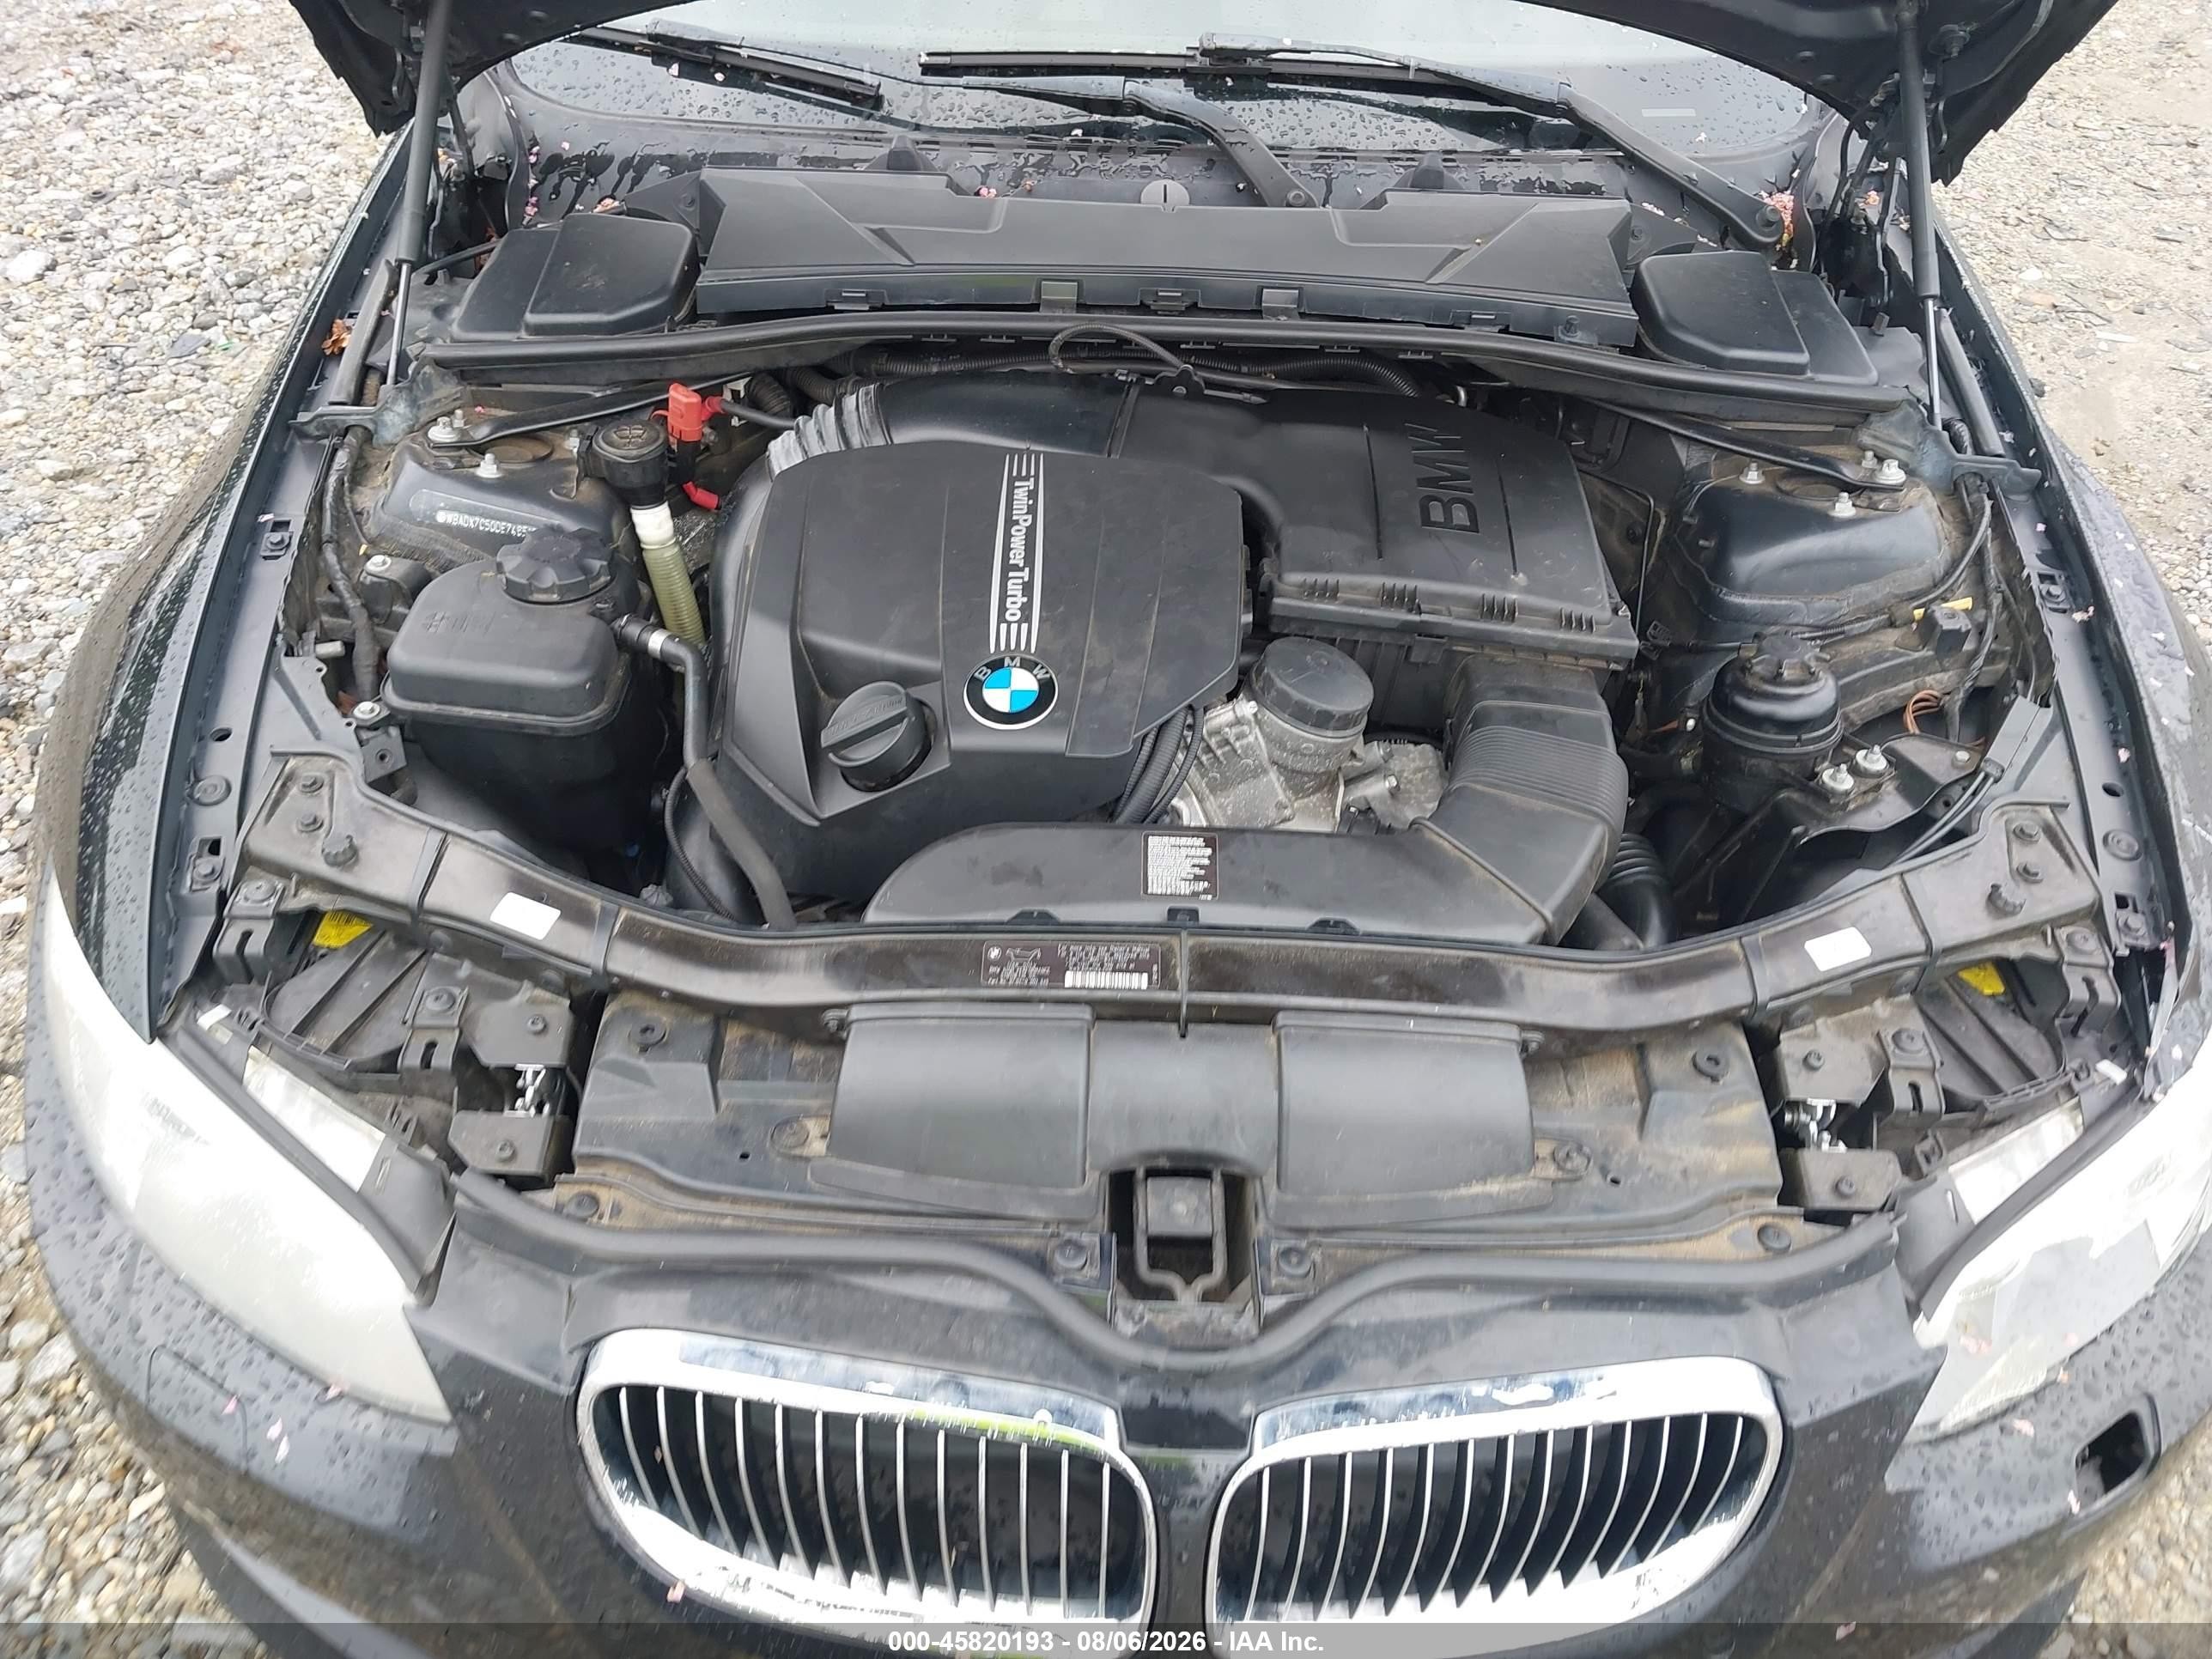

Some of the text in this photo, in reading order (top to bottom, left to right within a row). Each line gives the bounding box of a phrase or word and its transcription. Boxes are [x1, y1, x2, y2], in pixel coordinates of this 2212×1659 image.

[1402, 419, 1480, 535] BMW
[1005, 477, 1035, 622] TwinPower Turbo
